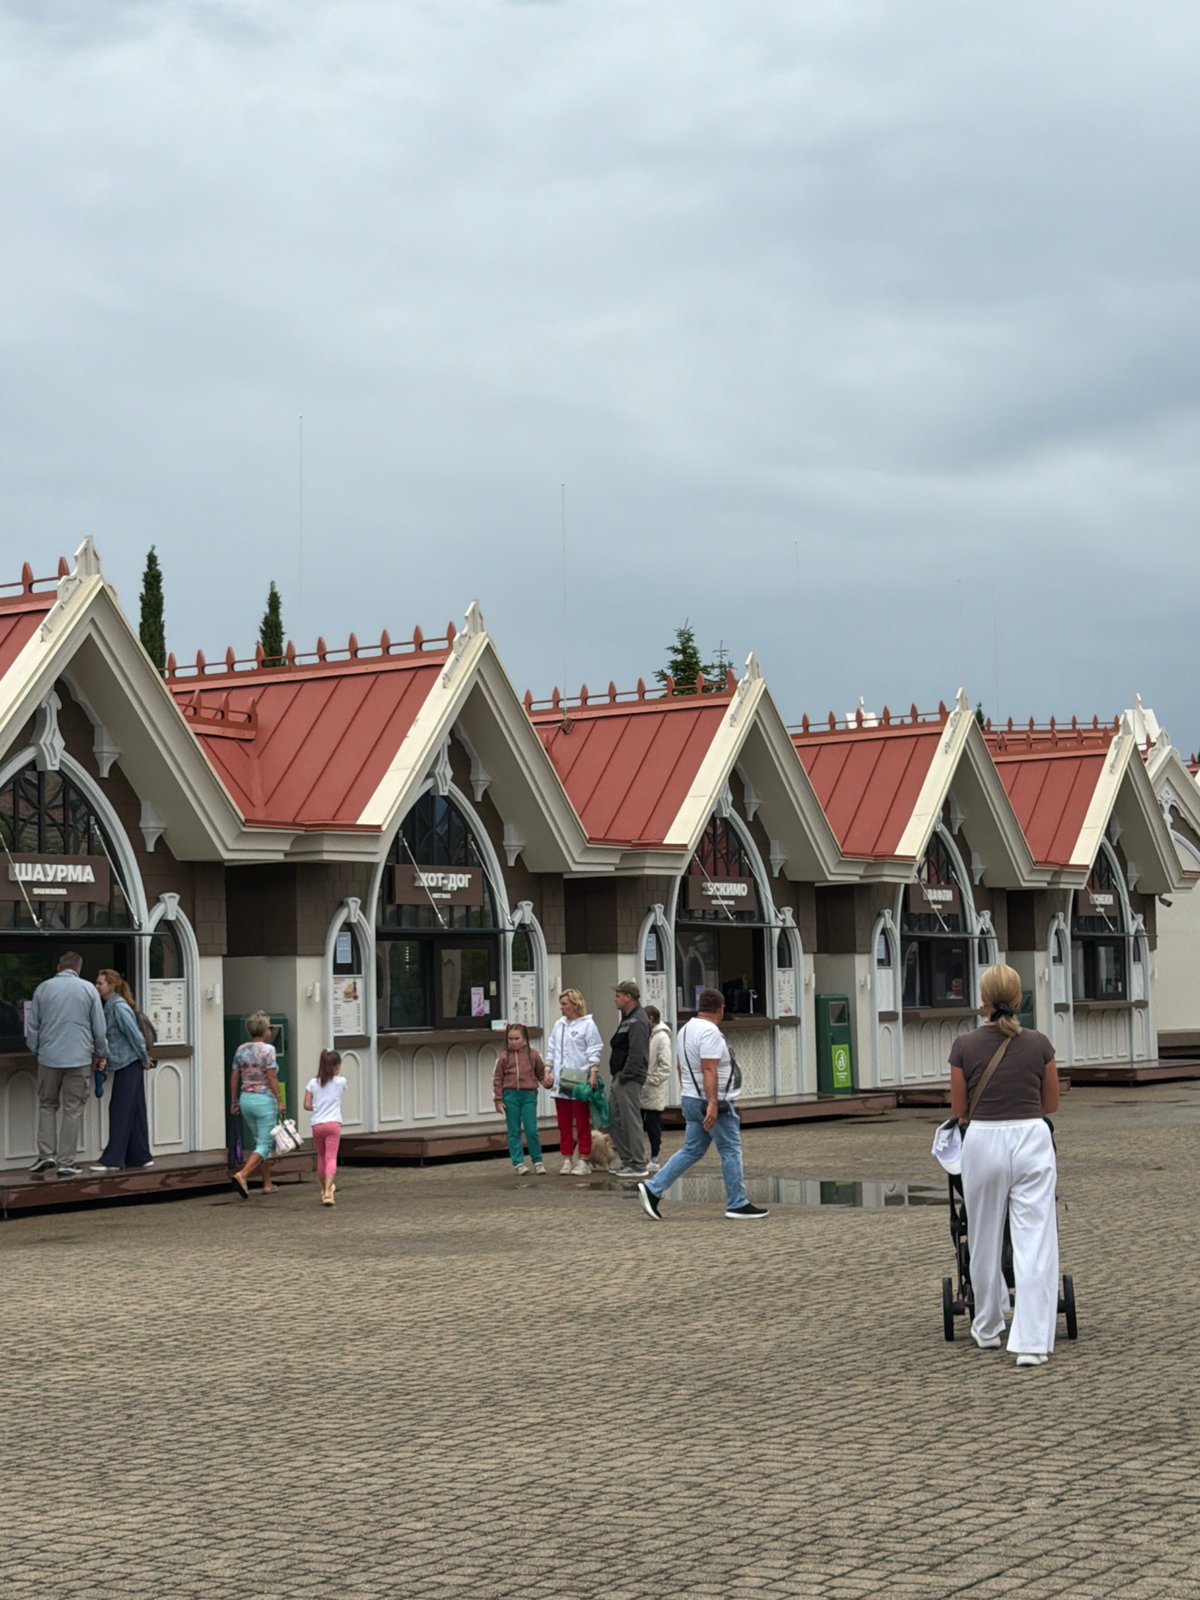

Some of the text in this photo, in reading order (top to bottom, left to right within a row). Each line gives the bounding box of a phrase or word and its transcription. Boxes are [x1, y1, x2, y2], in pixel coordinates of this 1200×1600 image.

[9, 863, 96, 883] ШАУРМА
[414, 872, 472, 891] ХОТ-ДОГ
[702, 882, 748, 897] ЭСКИМО
